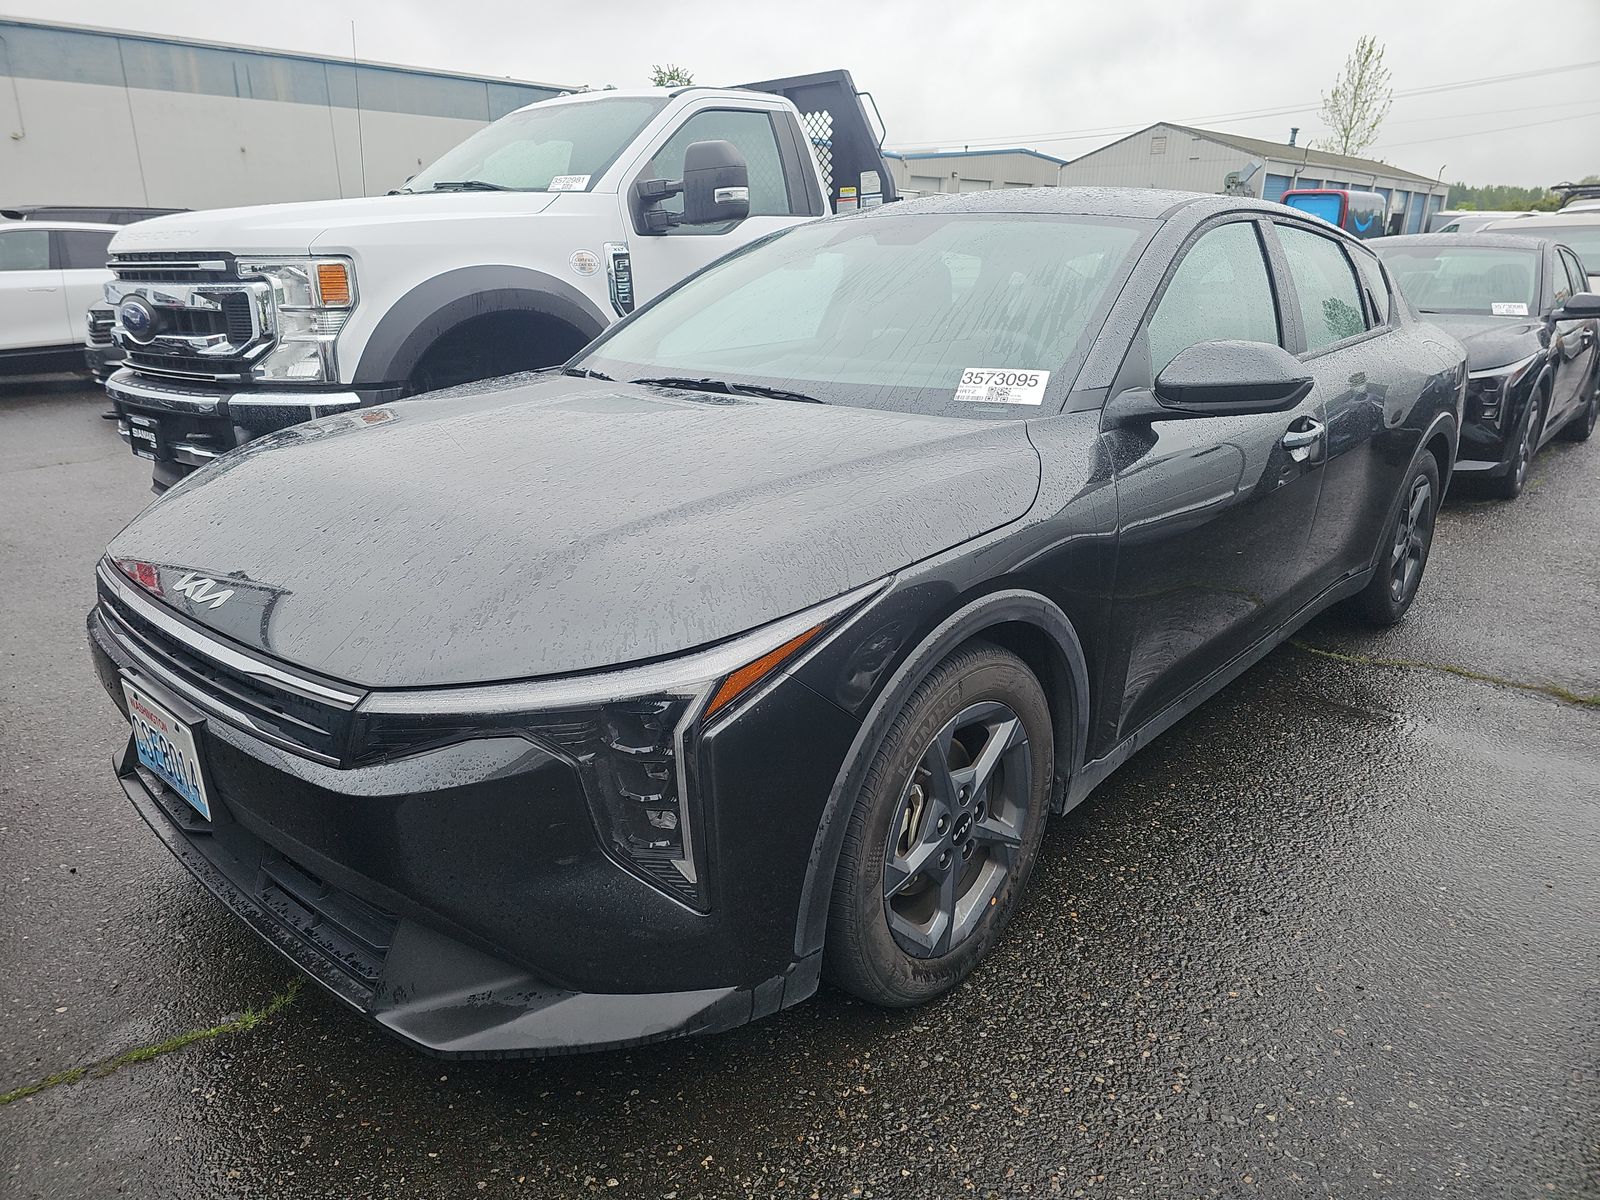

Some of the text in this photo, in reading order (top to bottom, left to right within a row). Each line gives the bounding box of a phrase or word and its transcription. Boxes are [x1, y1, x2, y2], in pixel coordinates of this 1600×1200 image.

[961, 371, 1040, 387] 3573095
[172, 571, 235, 611] KIA
[129, 696, 169, 734] WASHINGTON
[898, 687, 963, 778] KUMHO
